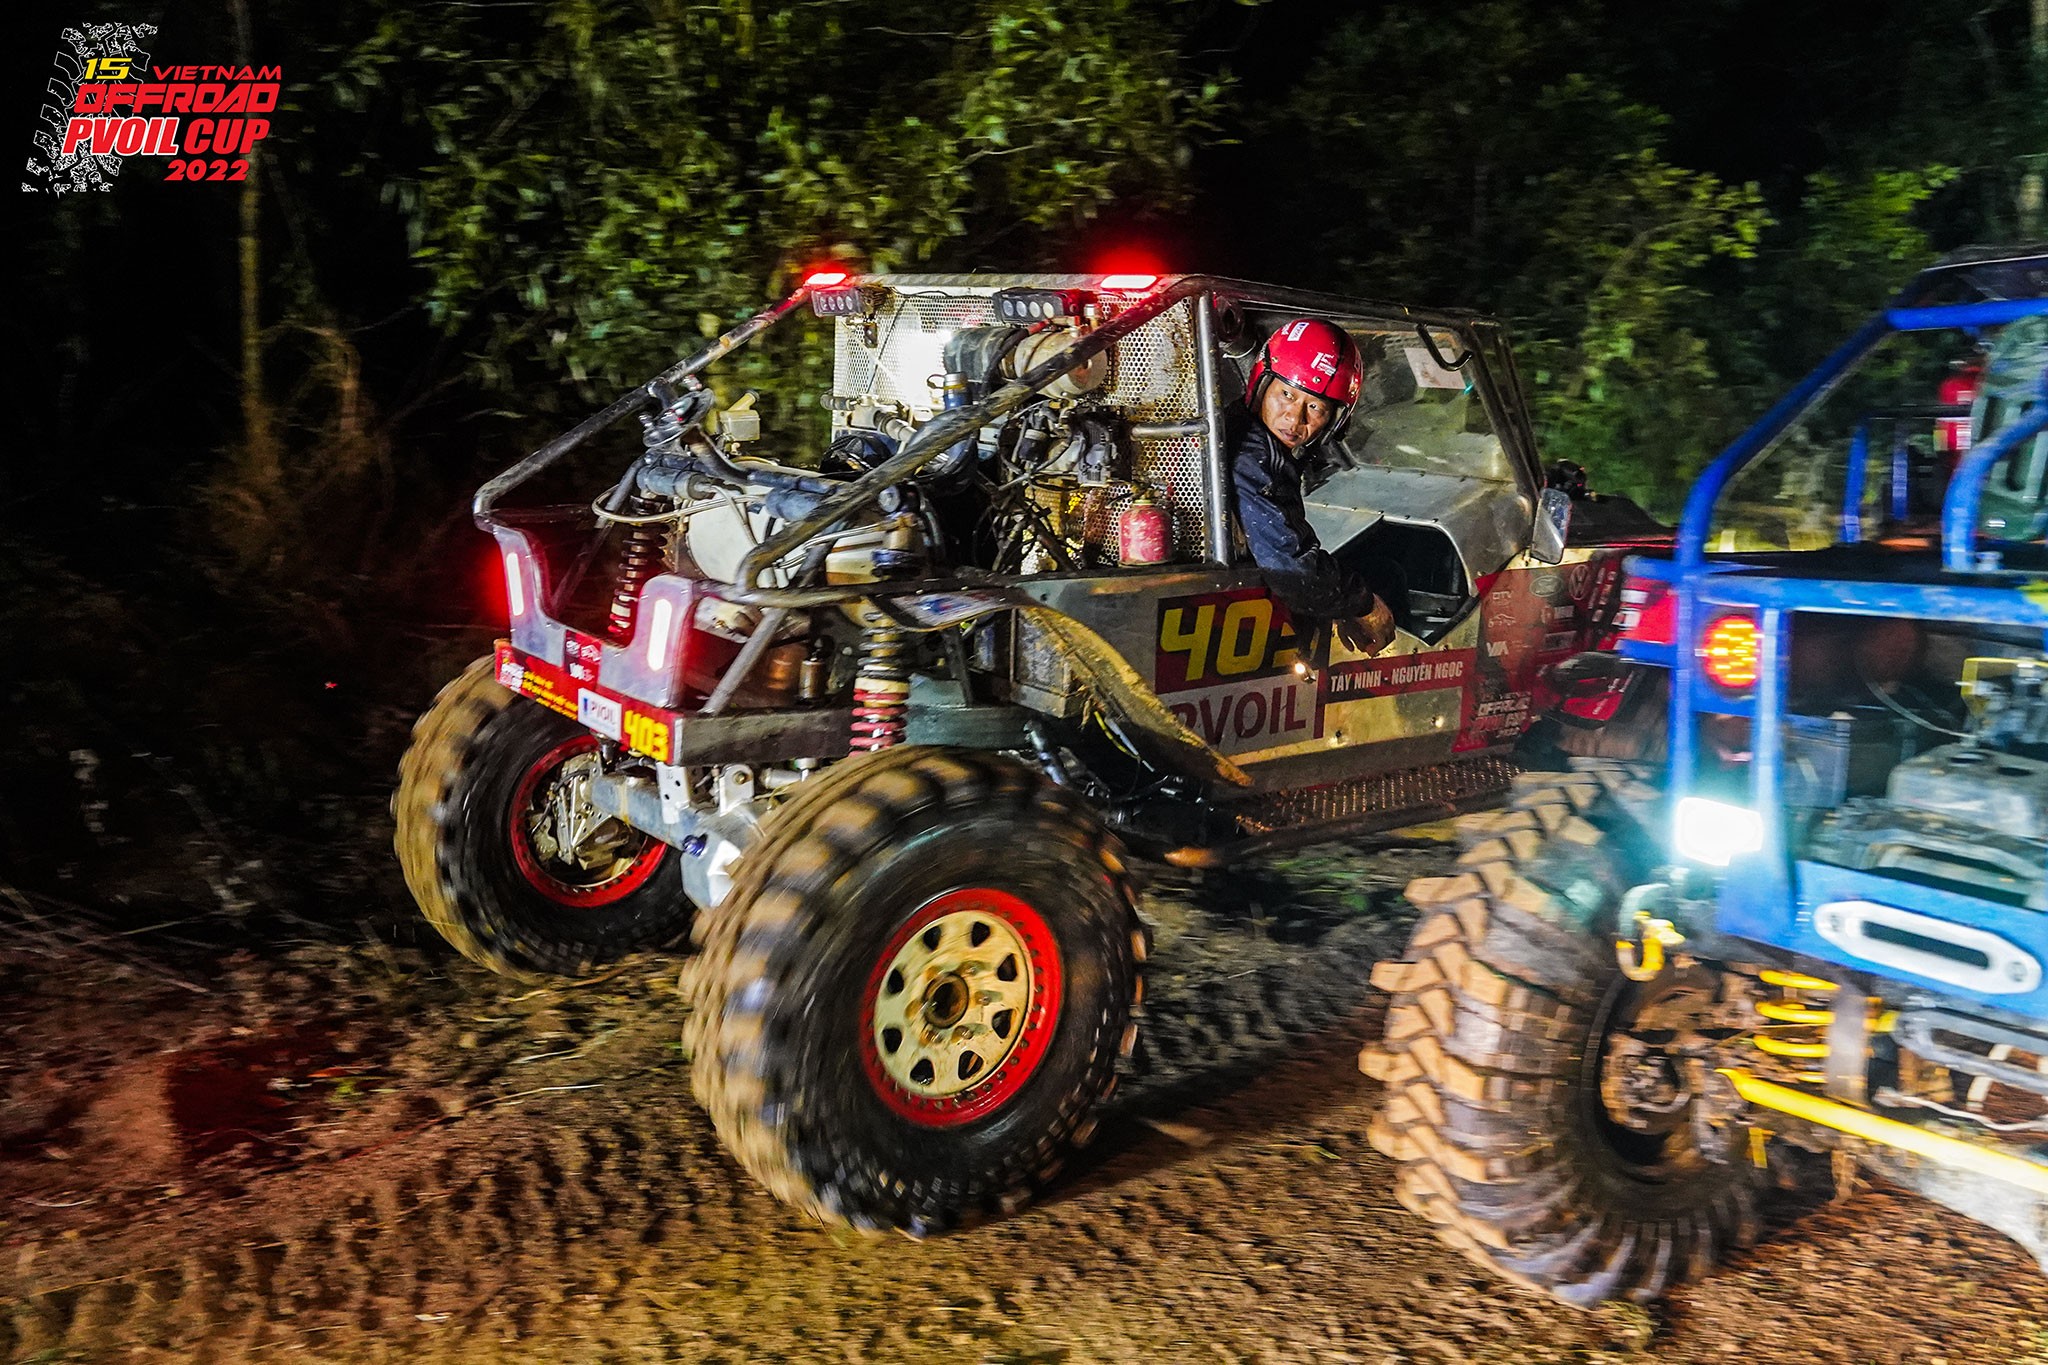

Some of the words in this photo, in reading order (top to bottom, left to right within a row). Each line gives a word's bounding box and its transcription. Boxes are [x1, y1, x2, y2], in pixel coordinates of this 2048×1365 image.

[1354, 670, 1382, 690] NINH
[1434, 661, 1463, 681] NGỌC
[624, 709, 669, 763] 403
